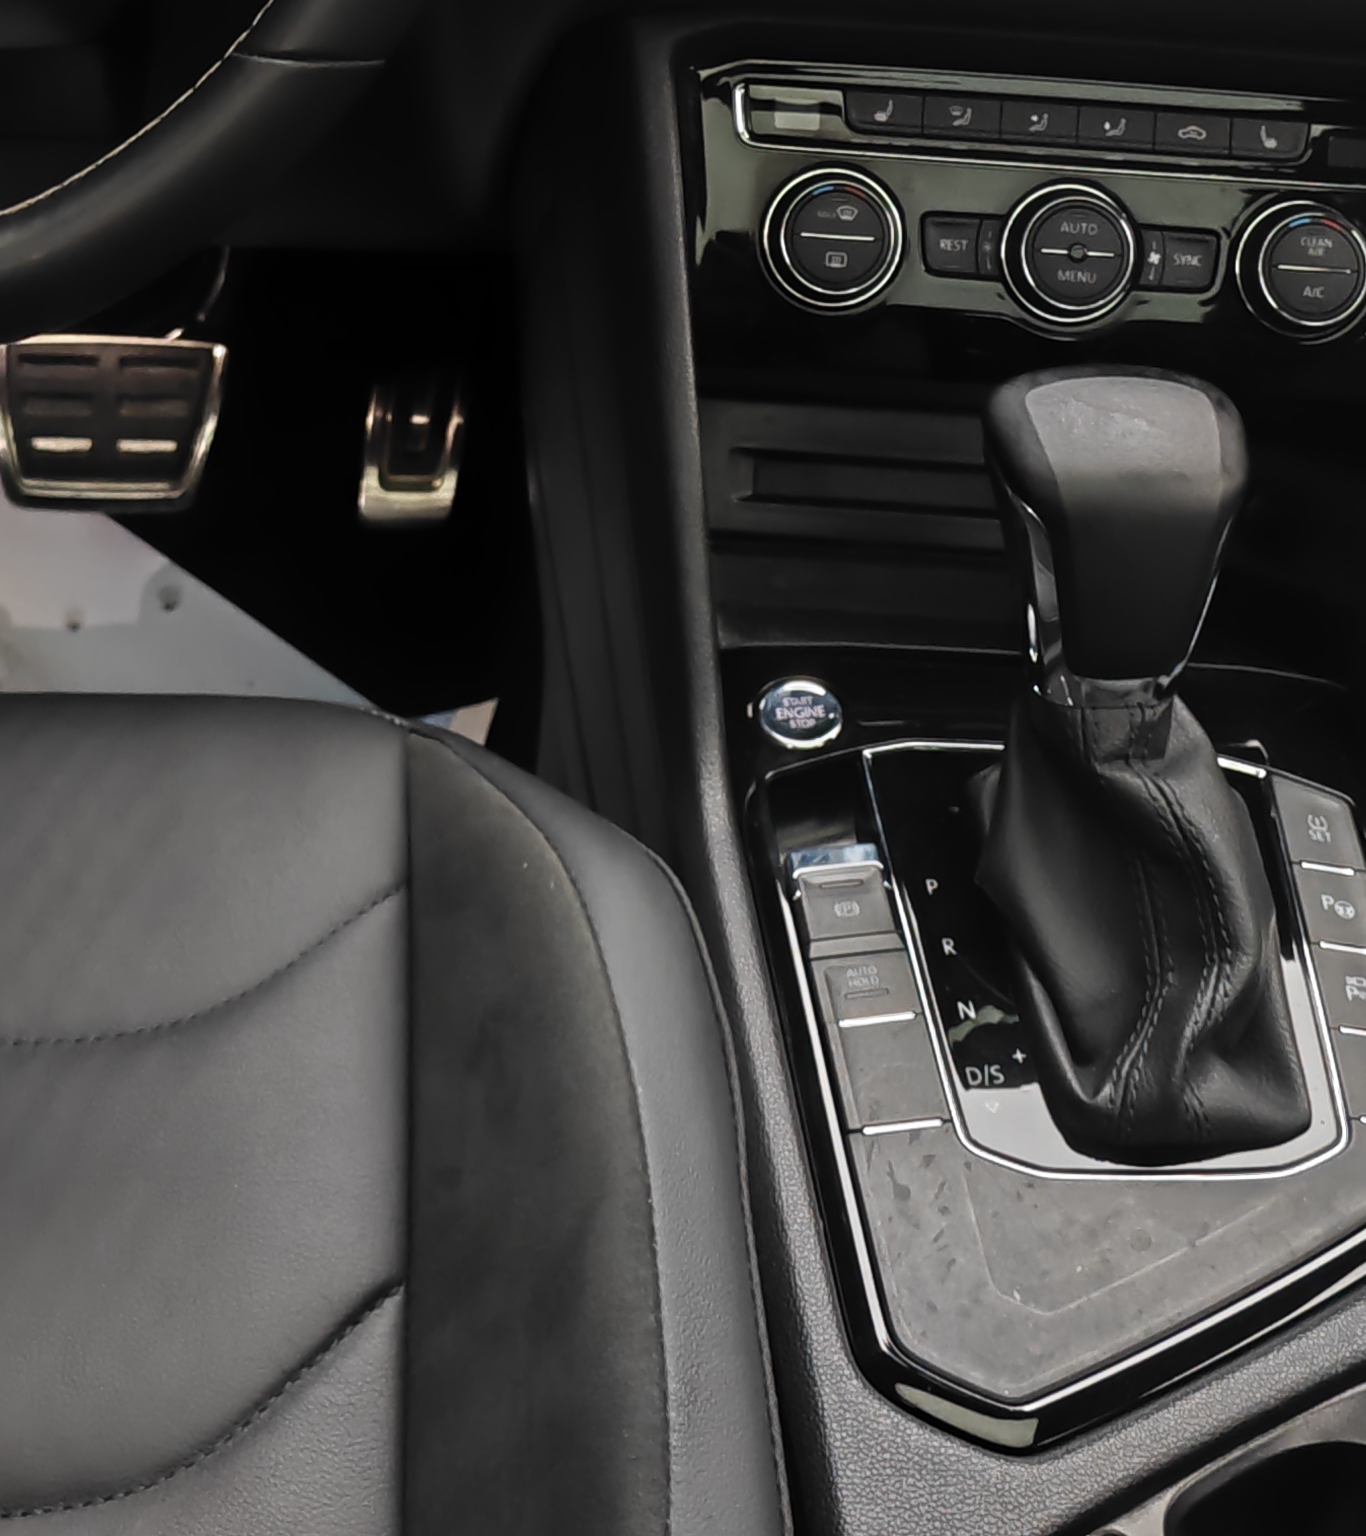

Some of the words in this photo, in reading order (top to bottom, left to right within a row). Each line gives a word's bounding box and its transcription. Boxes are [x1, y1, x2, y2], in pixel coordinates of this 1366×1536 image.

[1060, 221, 1099, 236] AUTO
[939, 238, 969, 252] REST
[1172, 253, 1202, 268] SYNC
[1057, 269, 1098, 284] MENU
[1302, 285, 1325, 299] A/C
[782, 695, 813, 707] START
[775, 704, 826, 721] ENGINE
[789, 718, 817, 729] STOP
[1308, 829, 1332, 843] SET
[925, 878, 939, 895] P
[942, 937, 958, 956] R
[846, 965, 878, 978] AUTO
[848, 975, 880, 989] HOLD
[957, 1001, 977, 1021] N
[966, 1063, 1005, 1087] D/S
